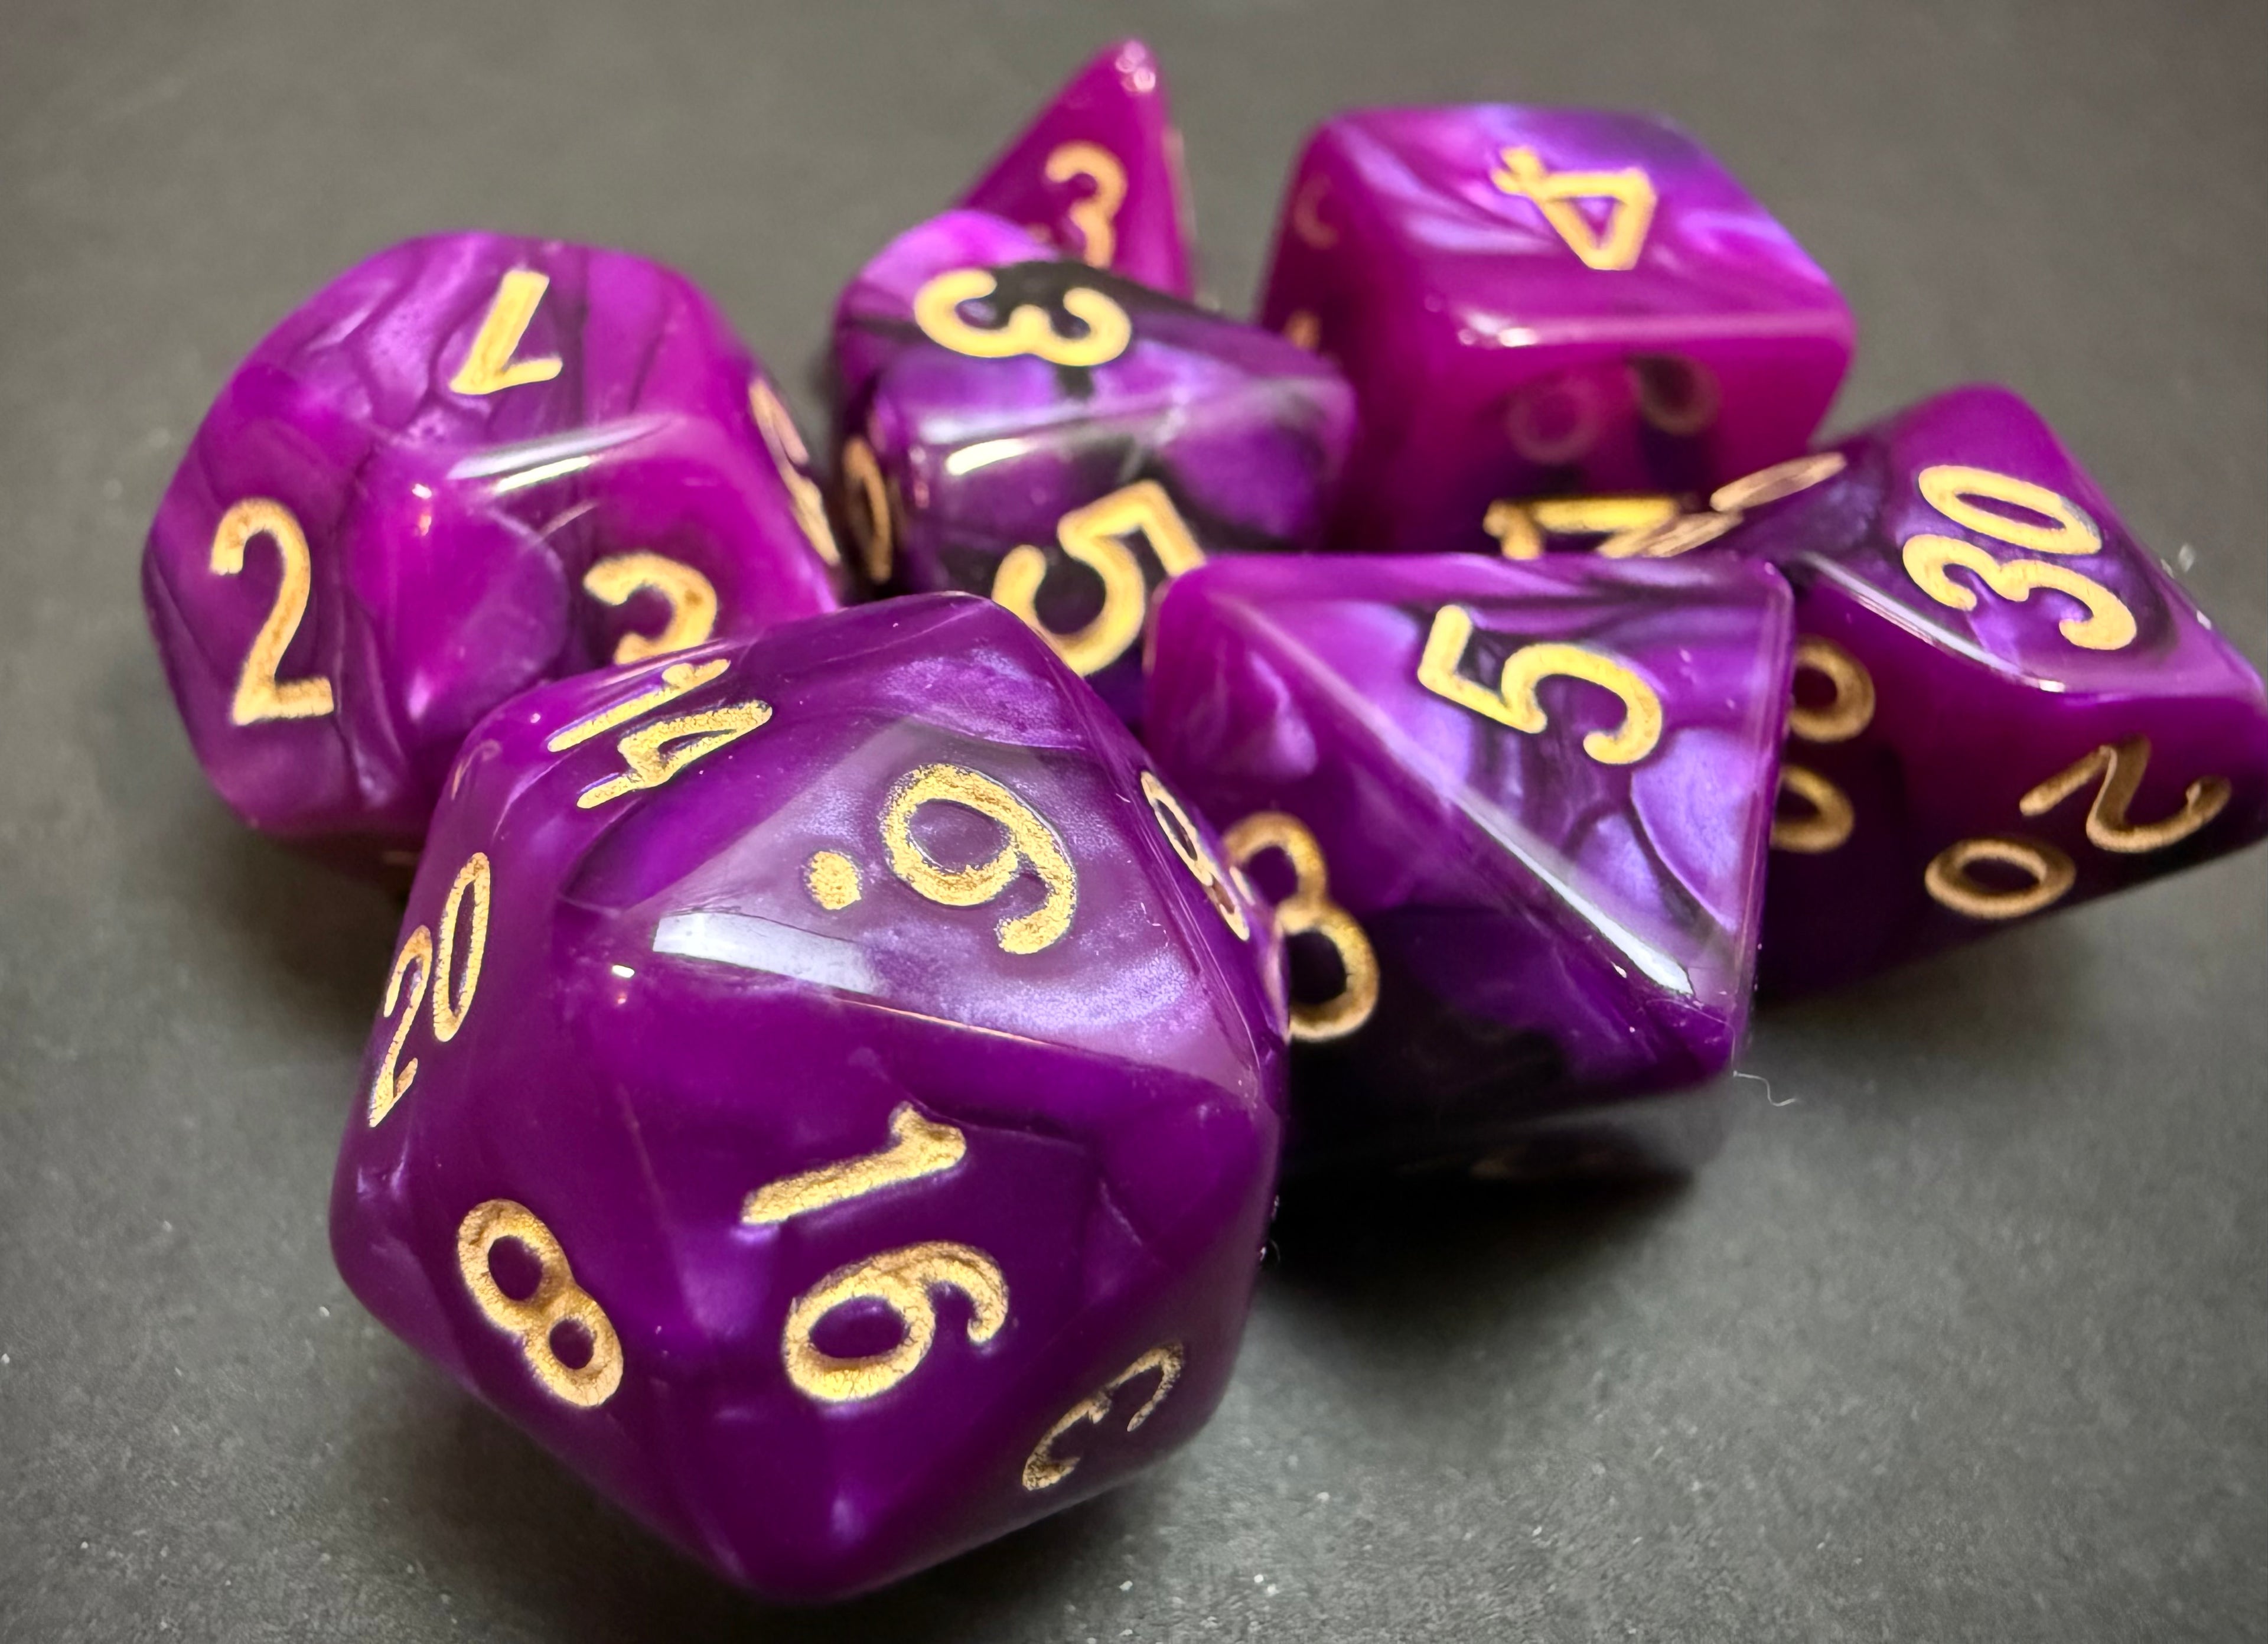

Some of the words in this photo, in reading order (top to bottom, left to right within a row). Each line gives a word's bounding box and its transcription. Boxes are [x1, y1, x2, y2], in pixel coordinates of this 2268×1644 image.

[1493, 147, 1655, 271] 4
[913, 267, 1132, 367] 3
[210, 498, 334, 725] 2
[992, 479, 1203, 677] 5
[1902, 464, 2137, 650] 30
[547, 659, 774, 809] 14
[1418, 604, 1663, 765] 5
[369, 852, 490, 1127] 20
[457, 1199, 624, 1408] 8
[744, 1102, 1009, 1403] 16
[1021, 1340, 1184, 1492] 3
